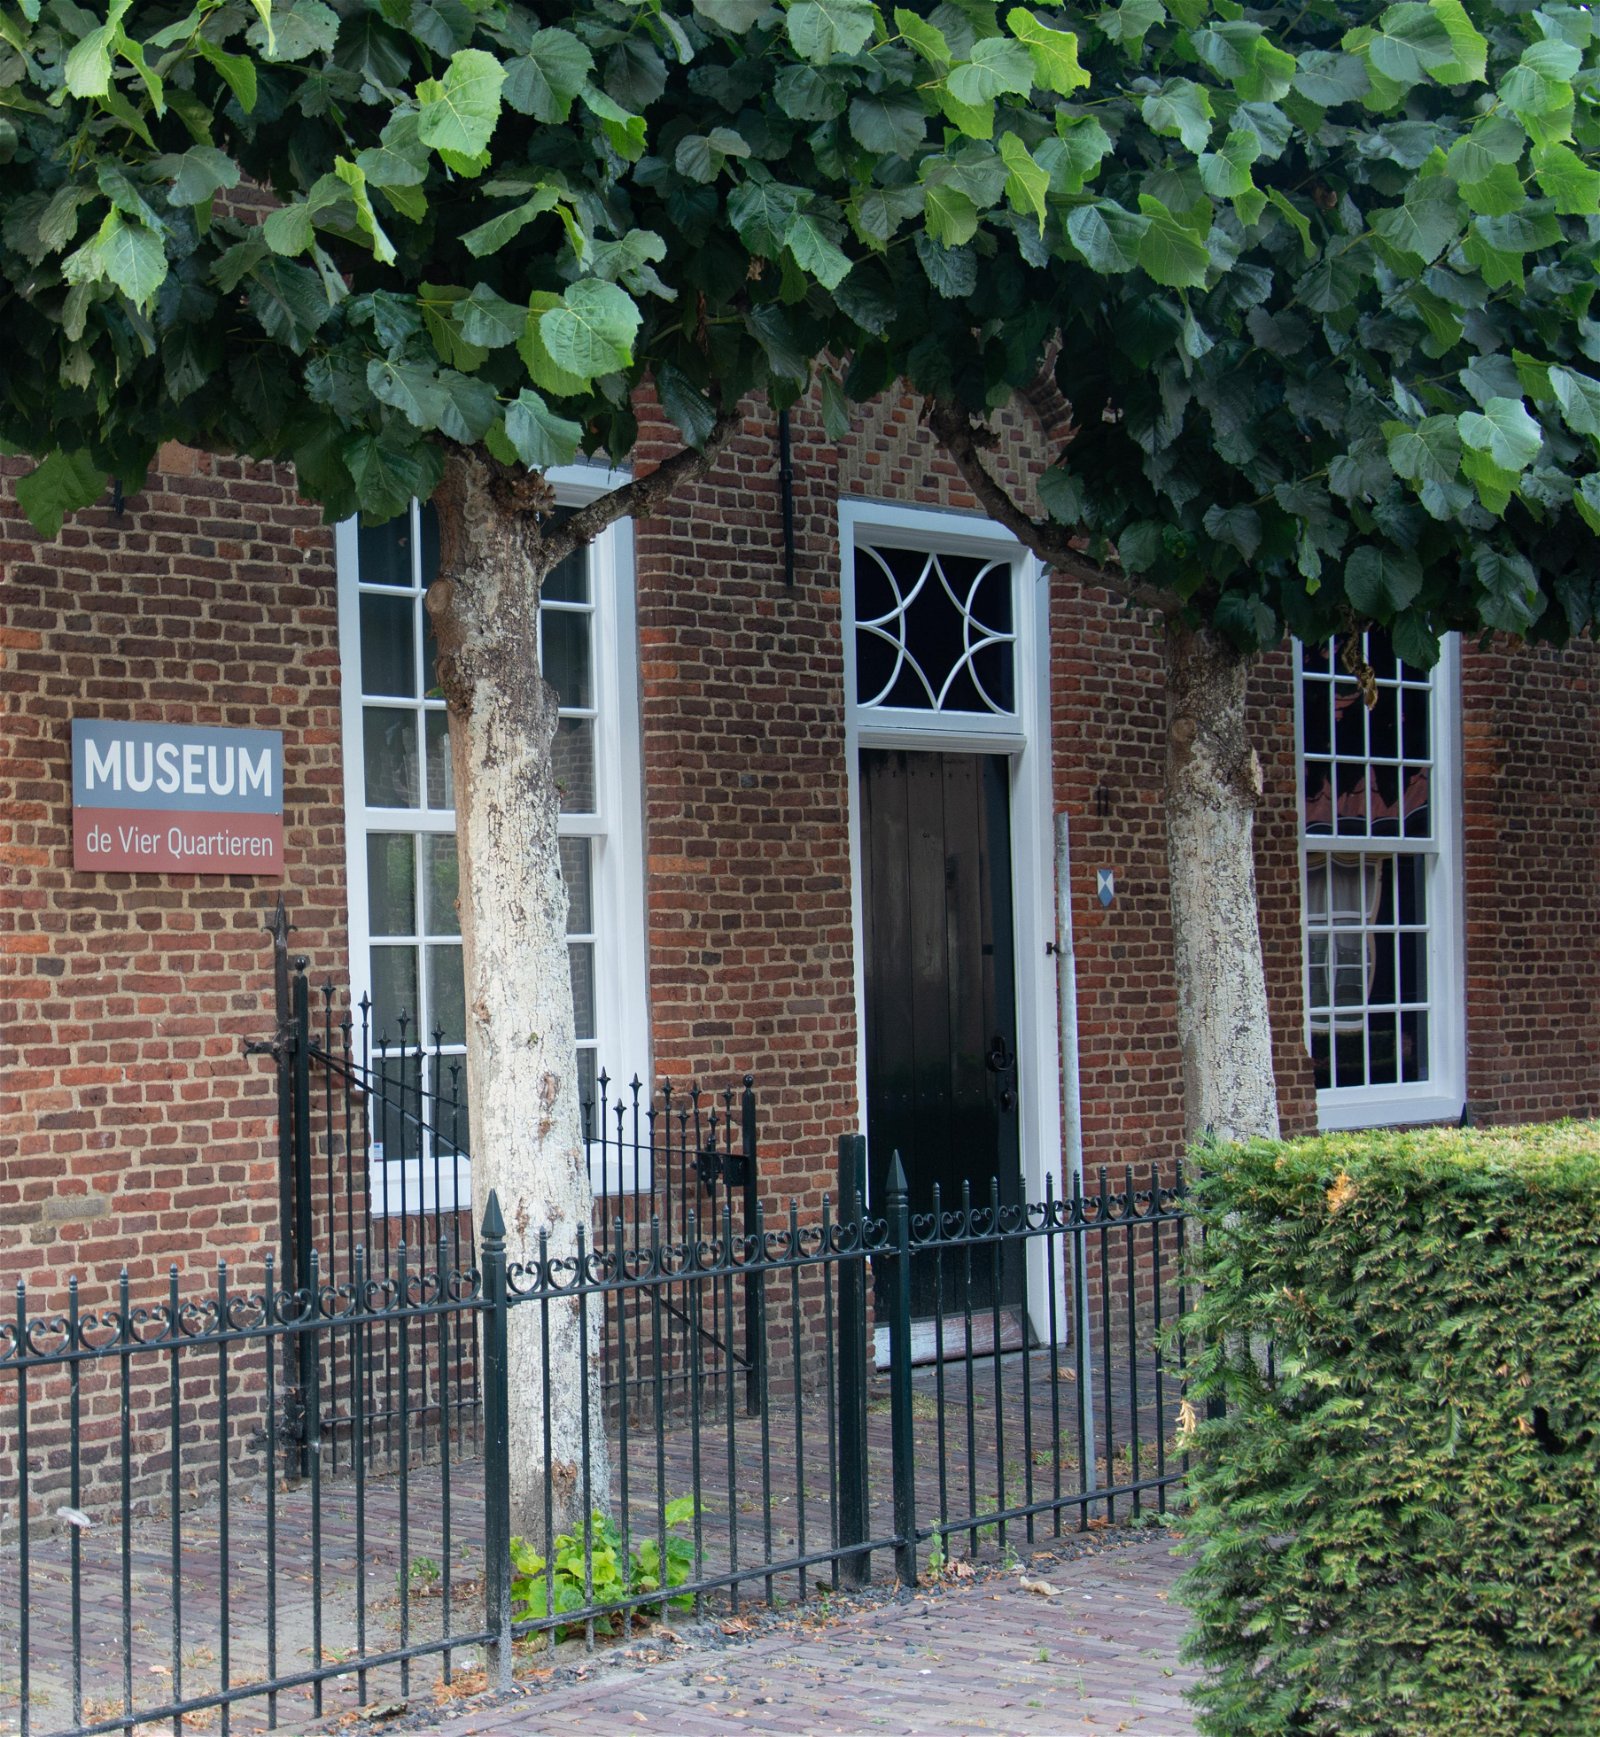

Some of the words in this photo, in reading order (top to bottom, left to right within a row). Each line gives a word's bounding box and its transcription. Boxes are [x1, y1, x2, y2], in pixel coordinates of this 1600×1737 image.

[85, 738, 272, 797] MUSEUM
[86, 824, 112, 853] de
[118, 826, 161, 854] Vier
[167, 827, 273, 859] Quartieren
